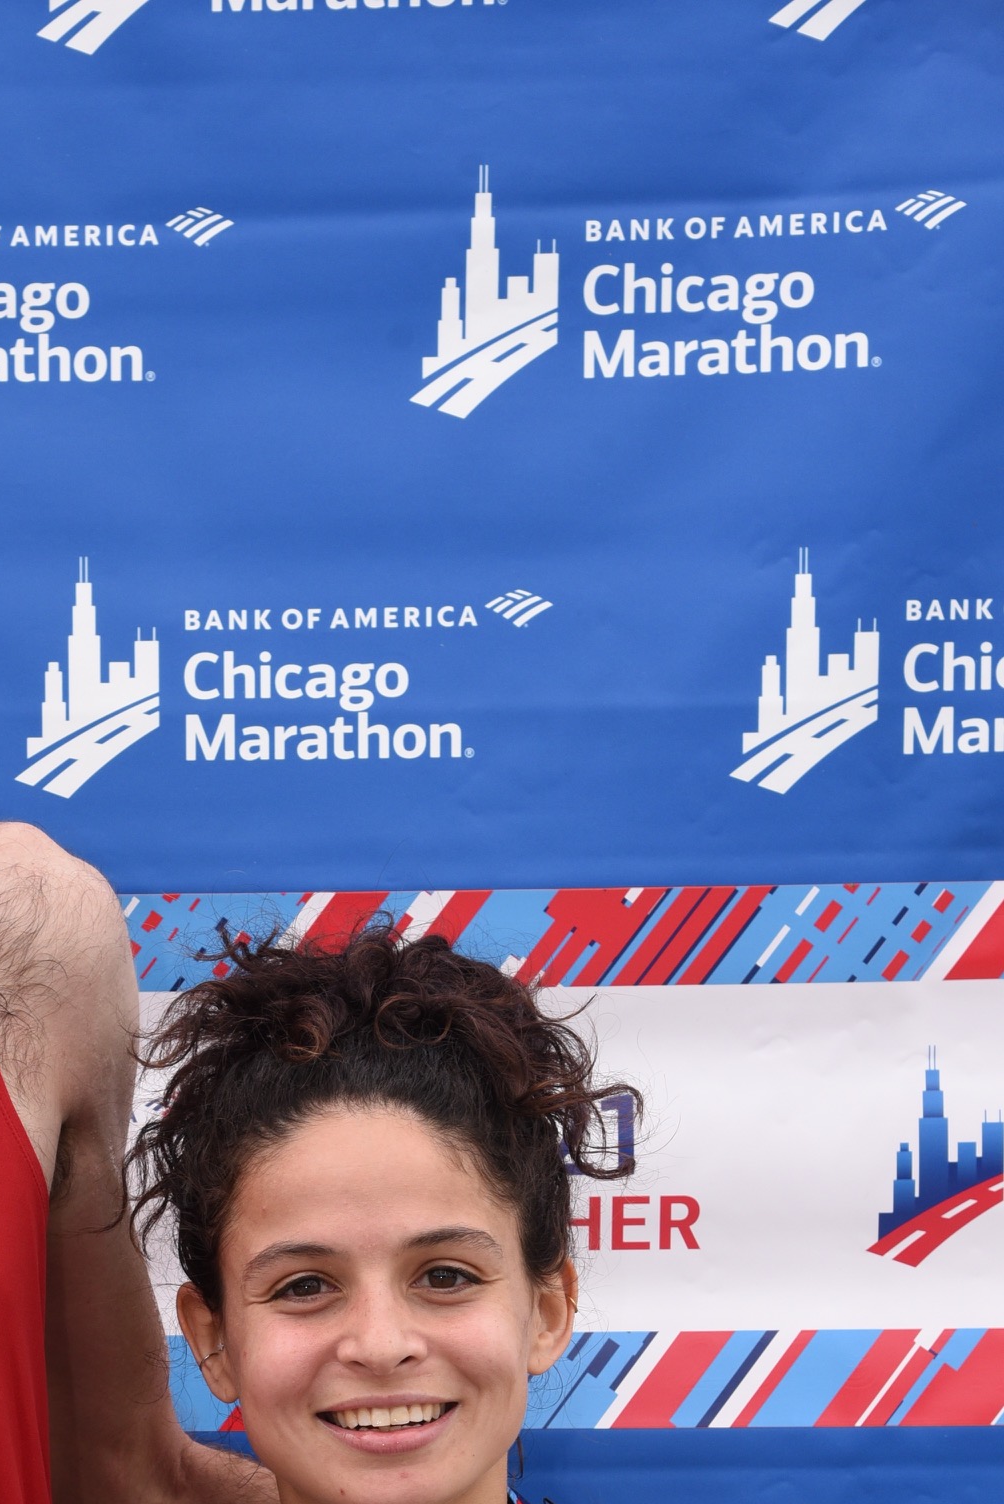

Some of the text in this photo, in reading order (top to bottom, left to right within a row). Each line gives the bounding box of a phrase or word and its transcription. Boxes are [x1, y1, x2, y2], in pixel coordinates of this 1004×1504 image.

[11, 225, 158, 246] AMERICA
[586, 210, 887, 241] BANK OF AMERICA
[583, 262, 815, 325] Chicago
[185, 606, 477, 630] BANK OF AMERICA
[906, 599, 992, 620] BANK
[184, 651, 408, 711] Chicago
